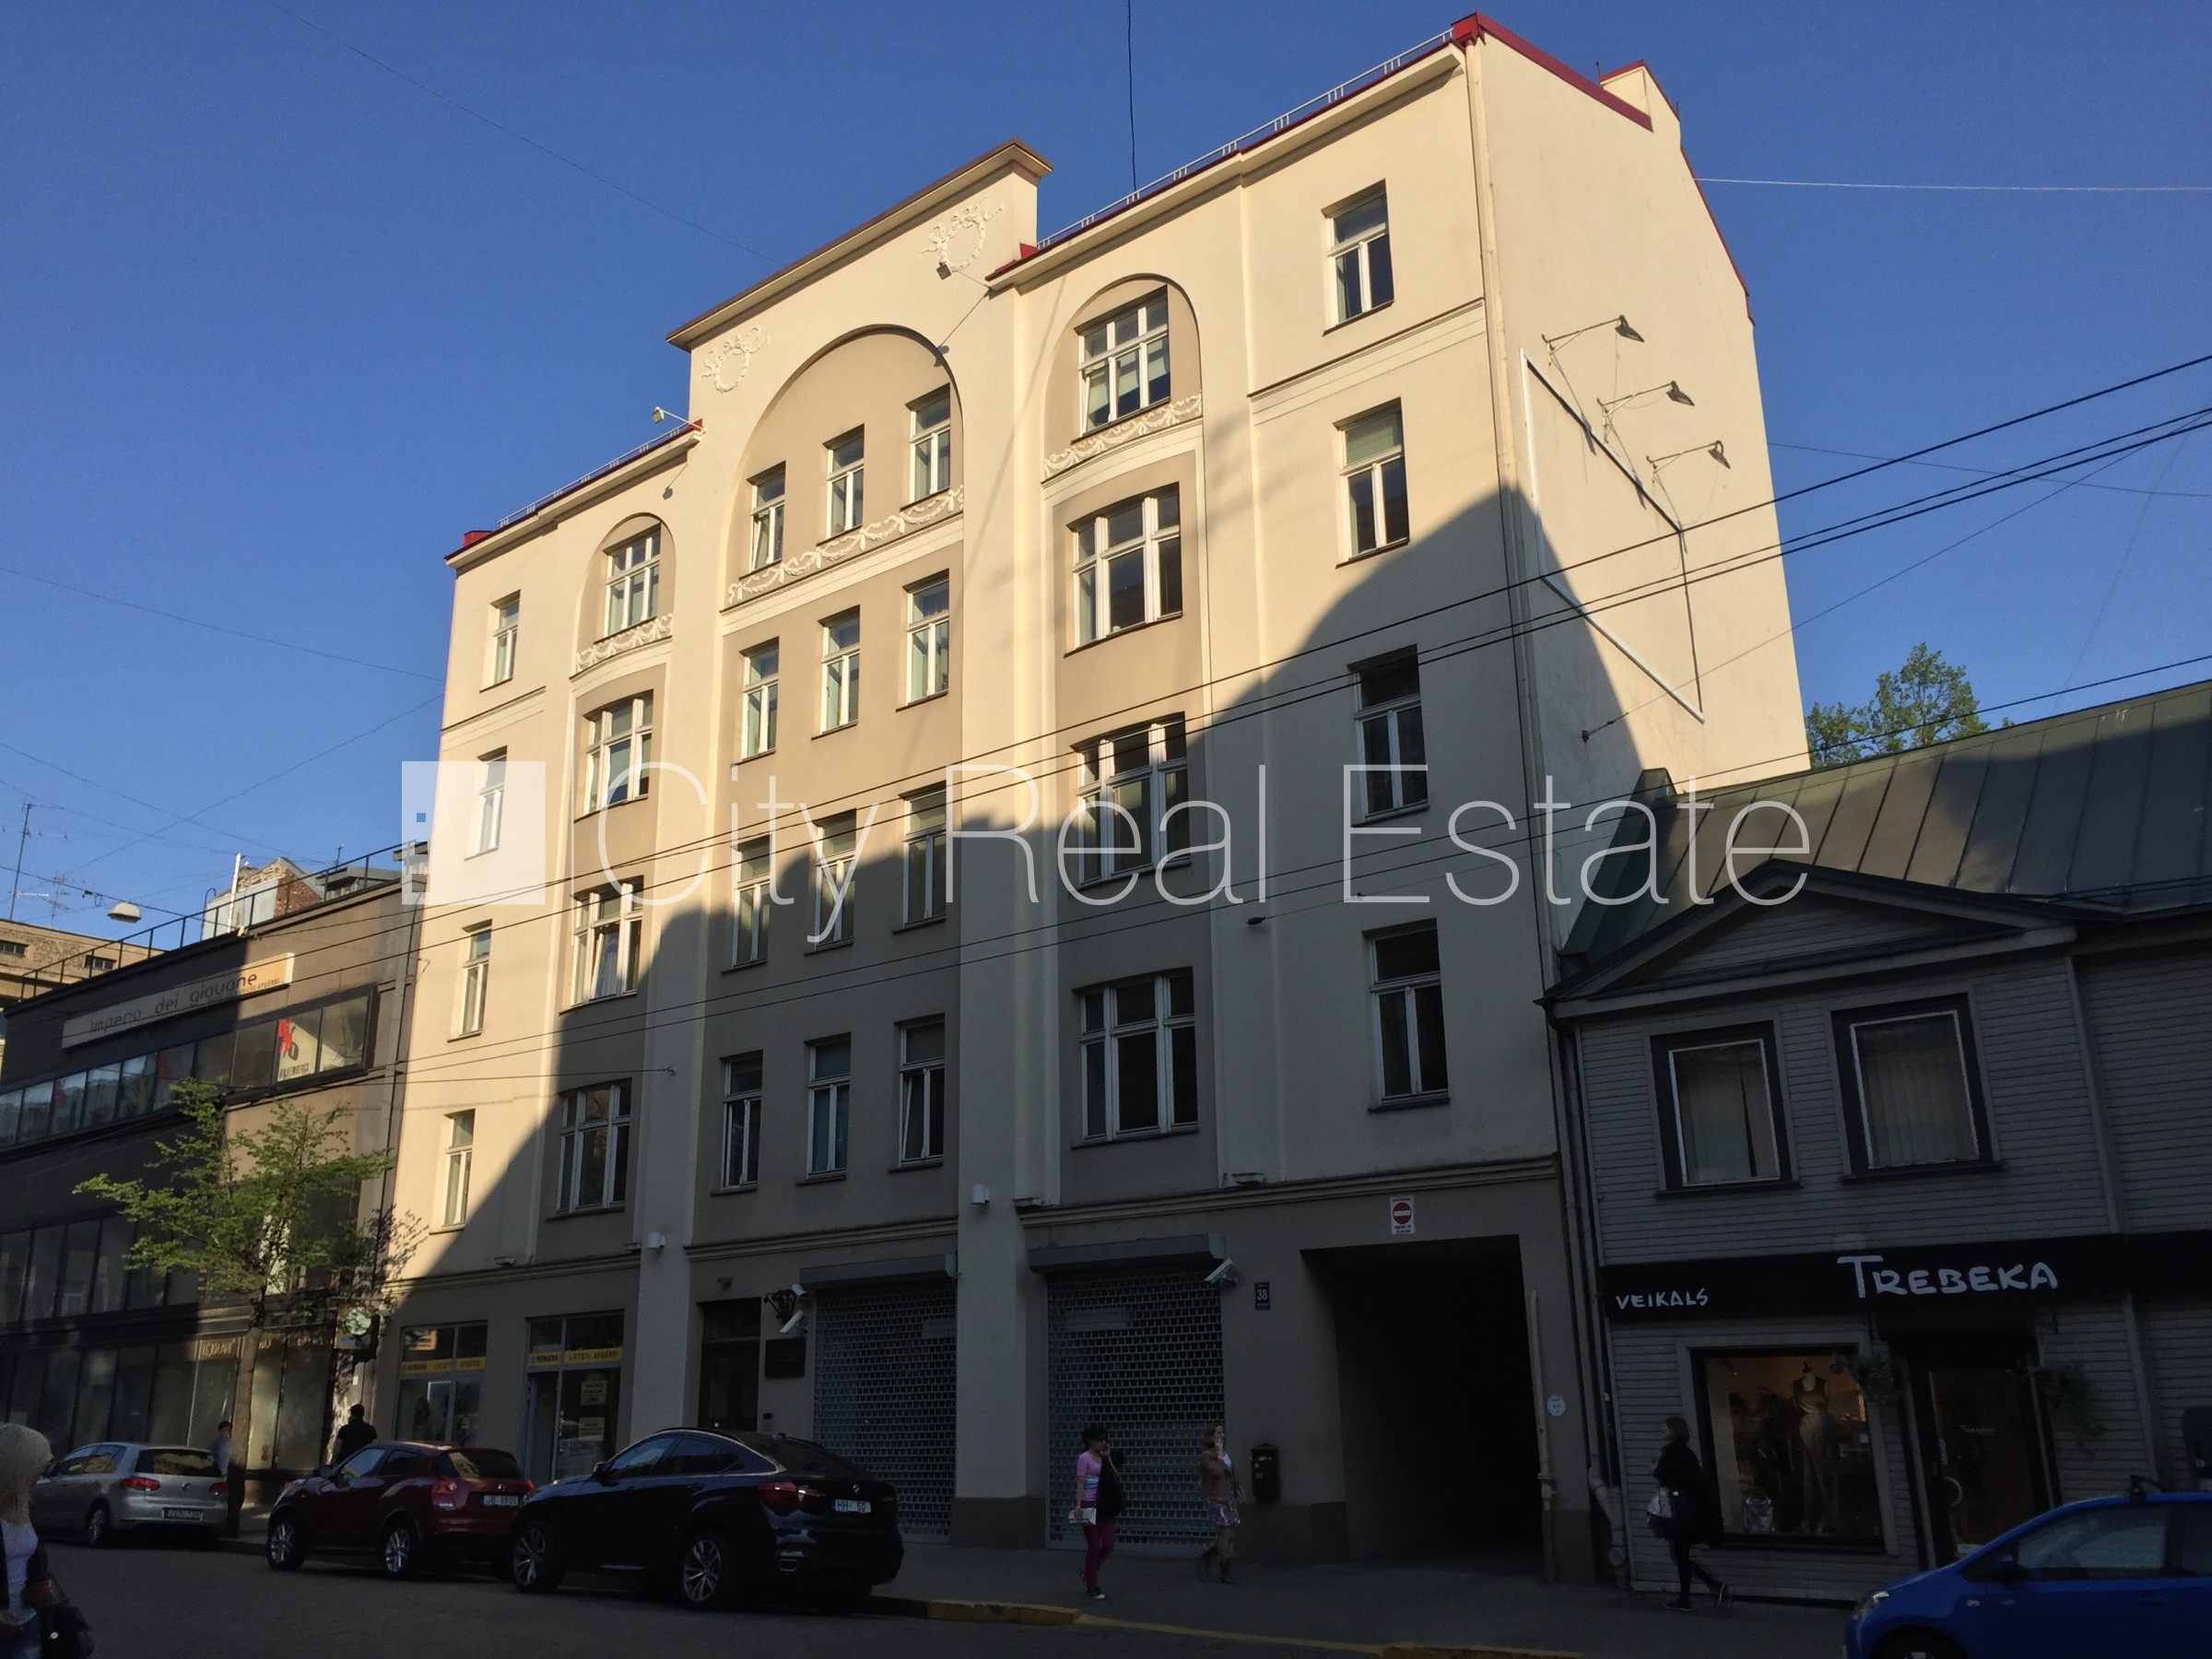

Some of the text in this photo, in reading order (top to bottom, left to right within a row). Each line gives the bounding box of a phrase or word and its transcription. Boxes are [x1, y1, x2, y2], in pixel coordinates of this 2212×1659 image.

[155, 992, 180, 1016] dei
[1256, 1288, 1268, 1300] 38
[1616, 1288, 1709, 1310] VEIKALS
